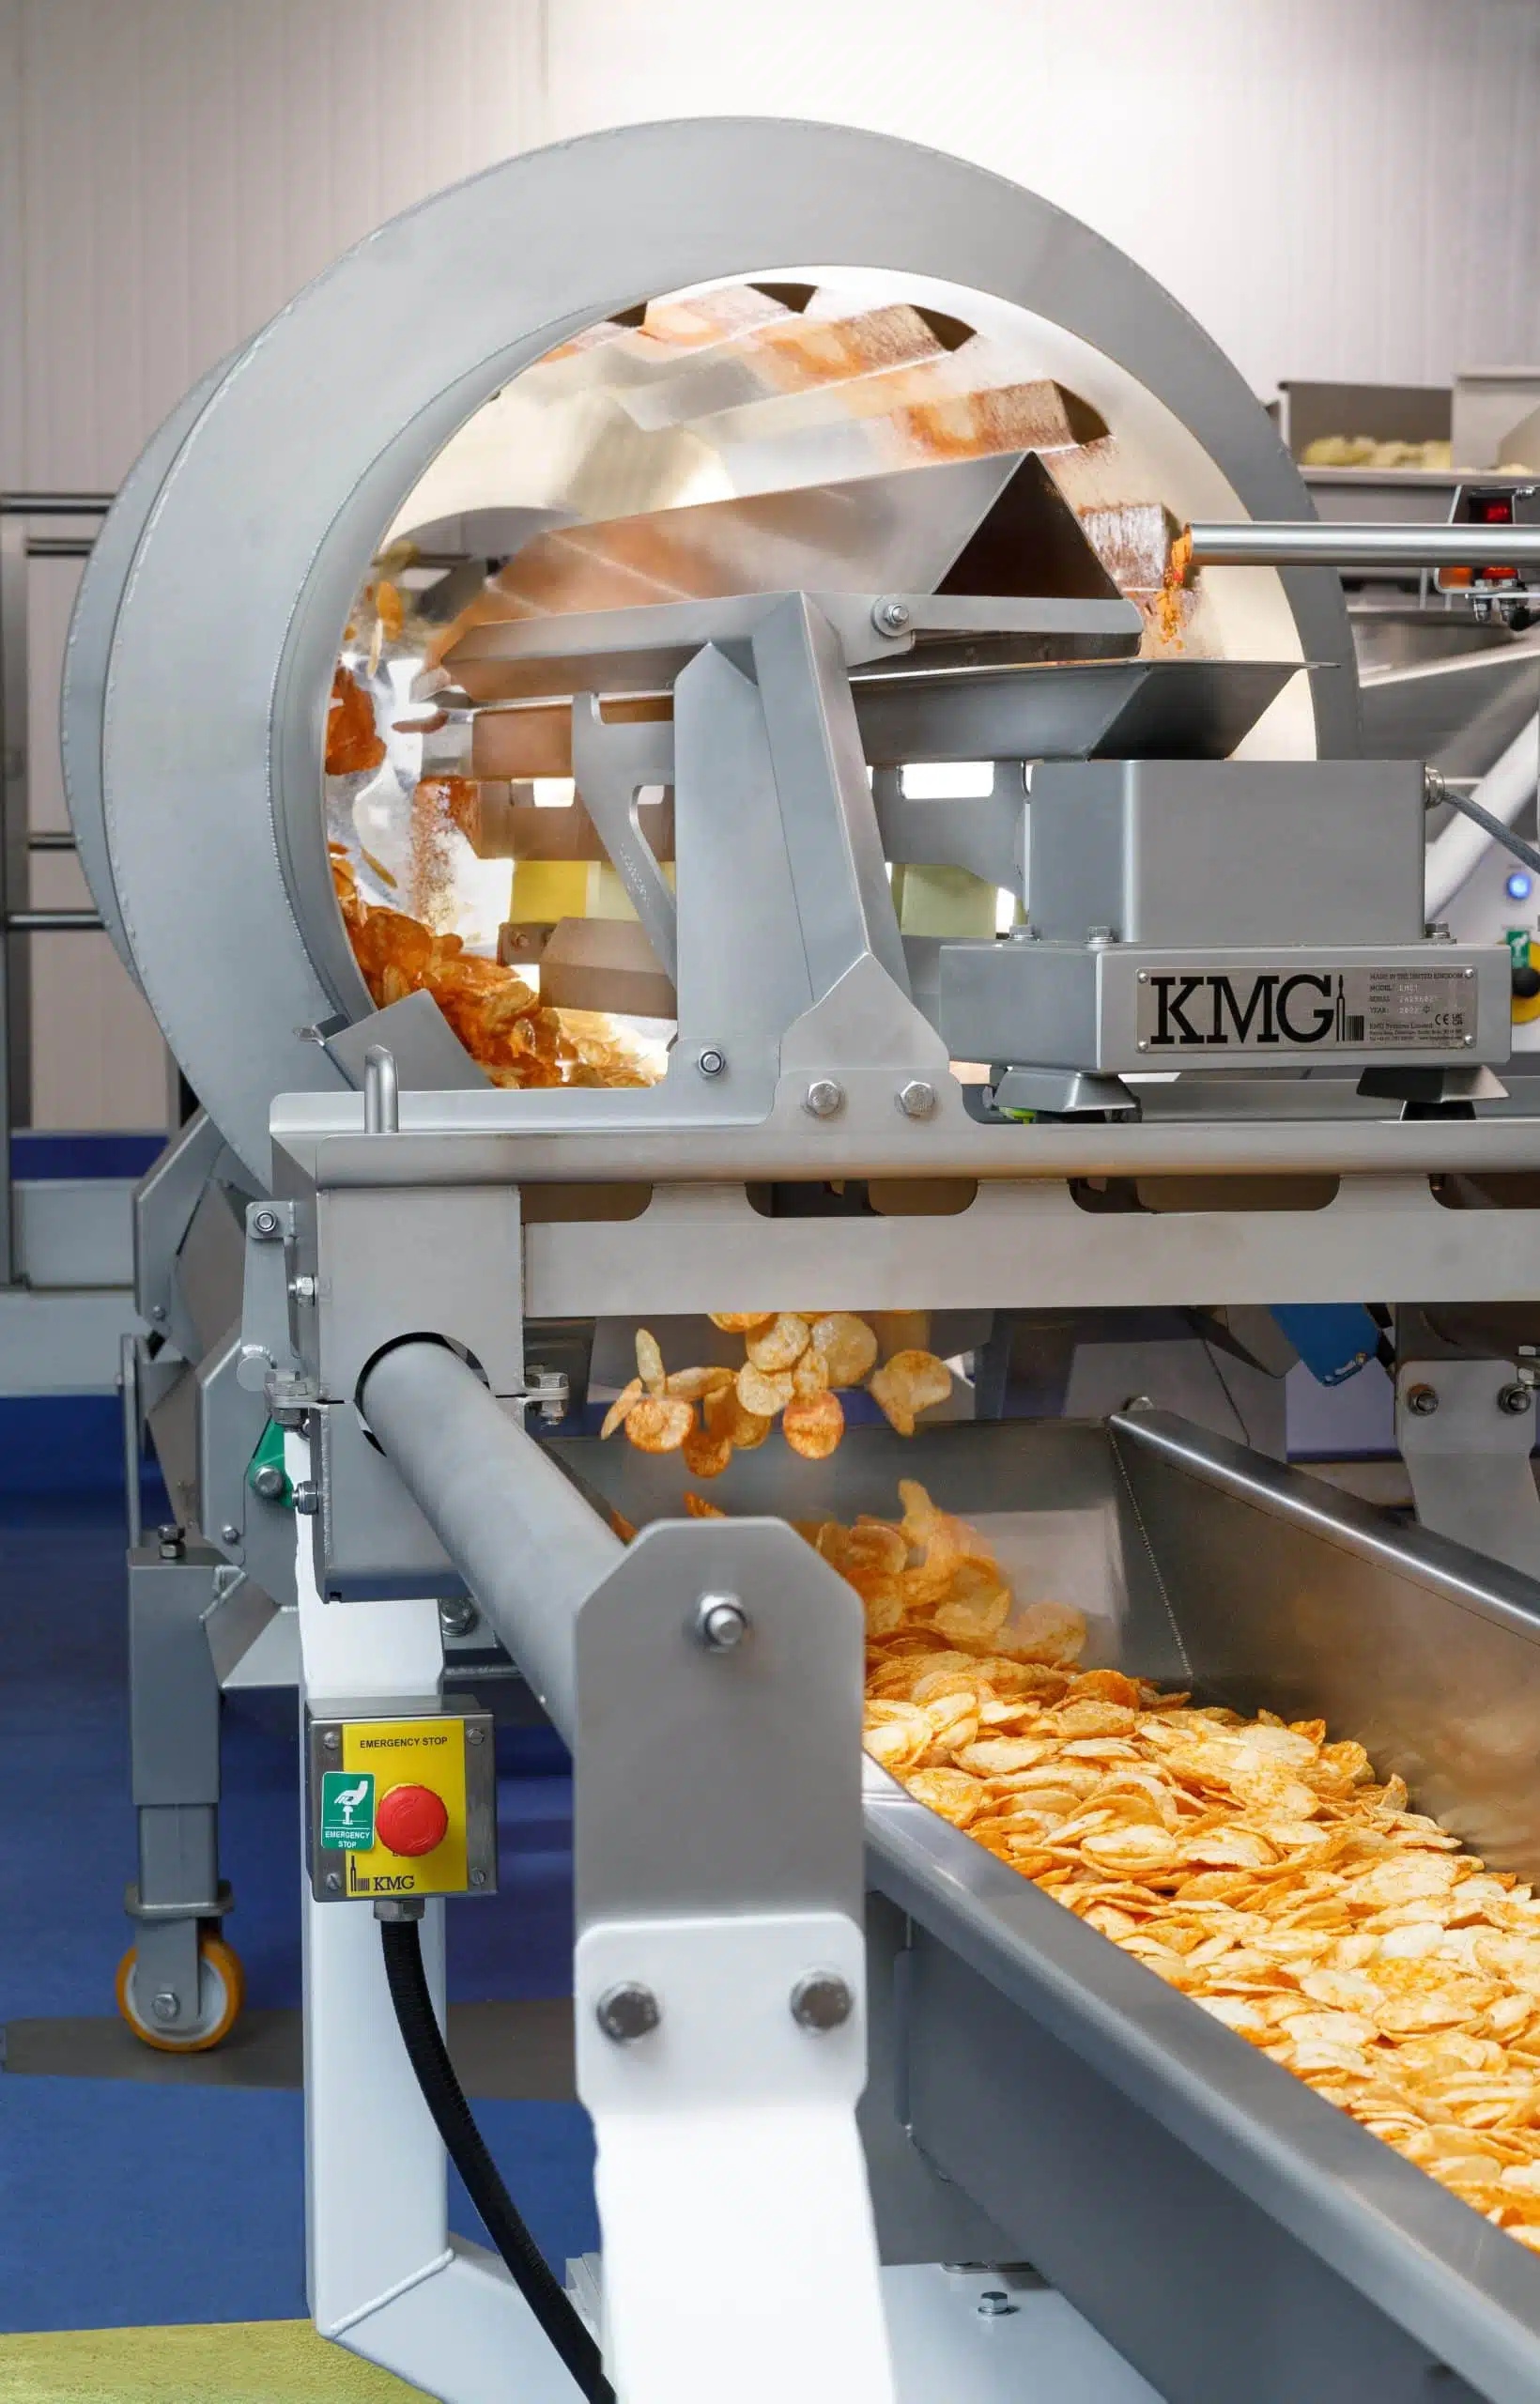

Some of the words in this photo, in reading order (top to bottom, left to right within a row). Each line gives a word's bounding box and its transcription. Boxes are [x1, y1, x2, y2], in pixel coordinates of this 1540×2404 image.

[1150, 974, 1334, 1044] KMG
[360, 1737, 421, 1749] EMERGENCY
[423, 1736, 448, 1746] STOP
[325, 1830, 371, 1840] EMERGENCY
[373, 1875, 415, 1891] KMG
